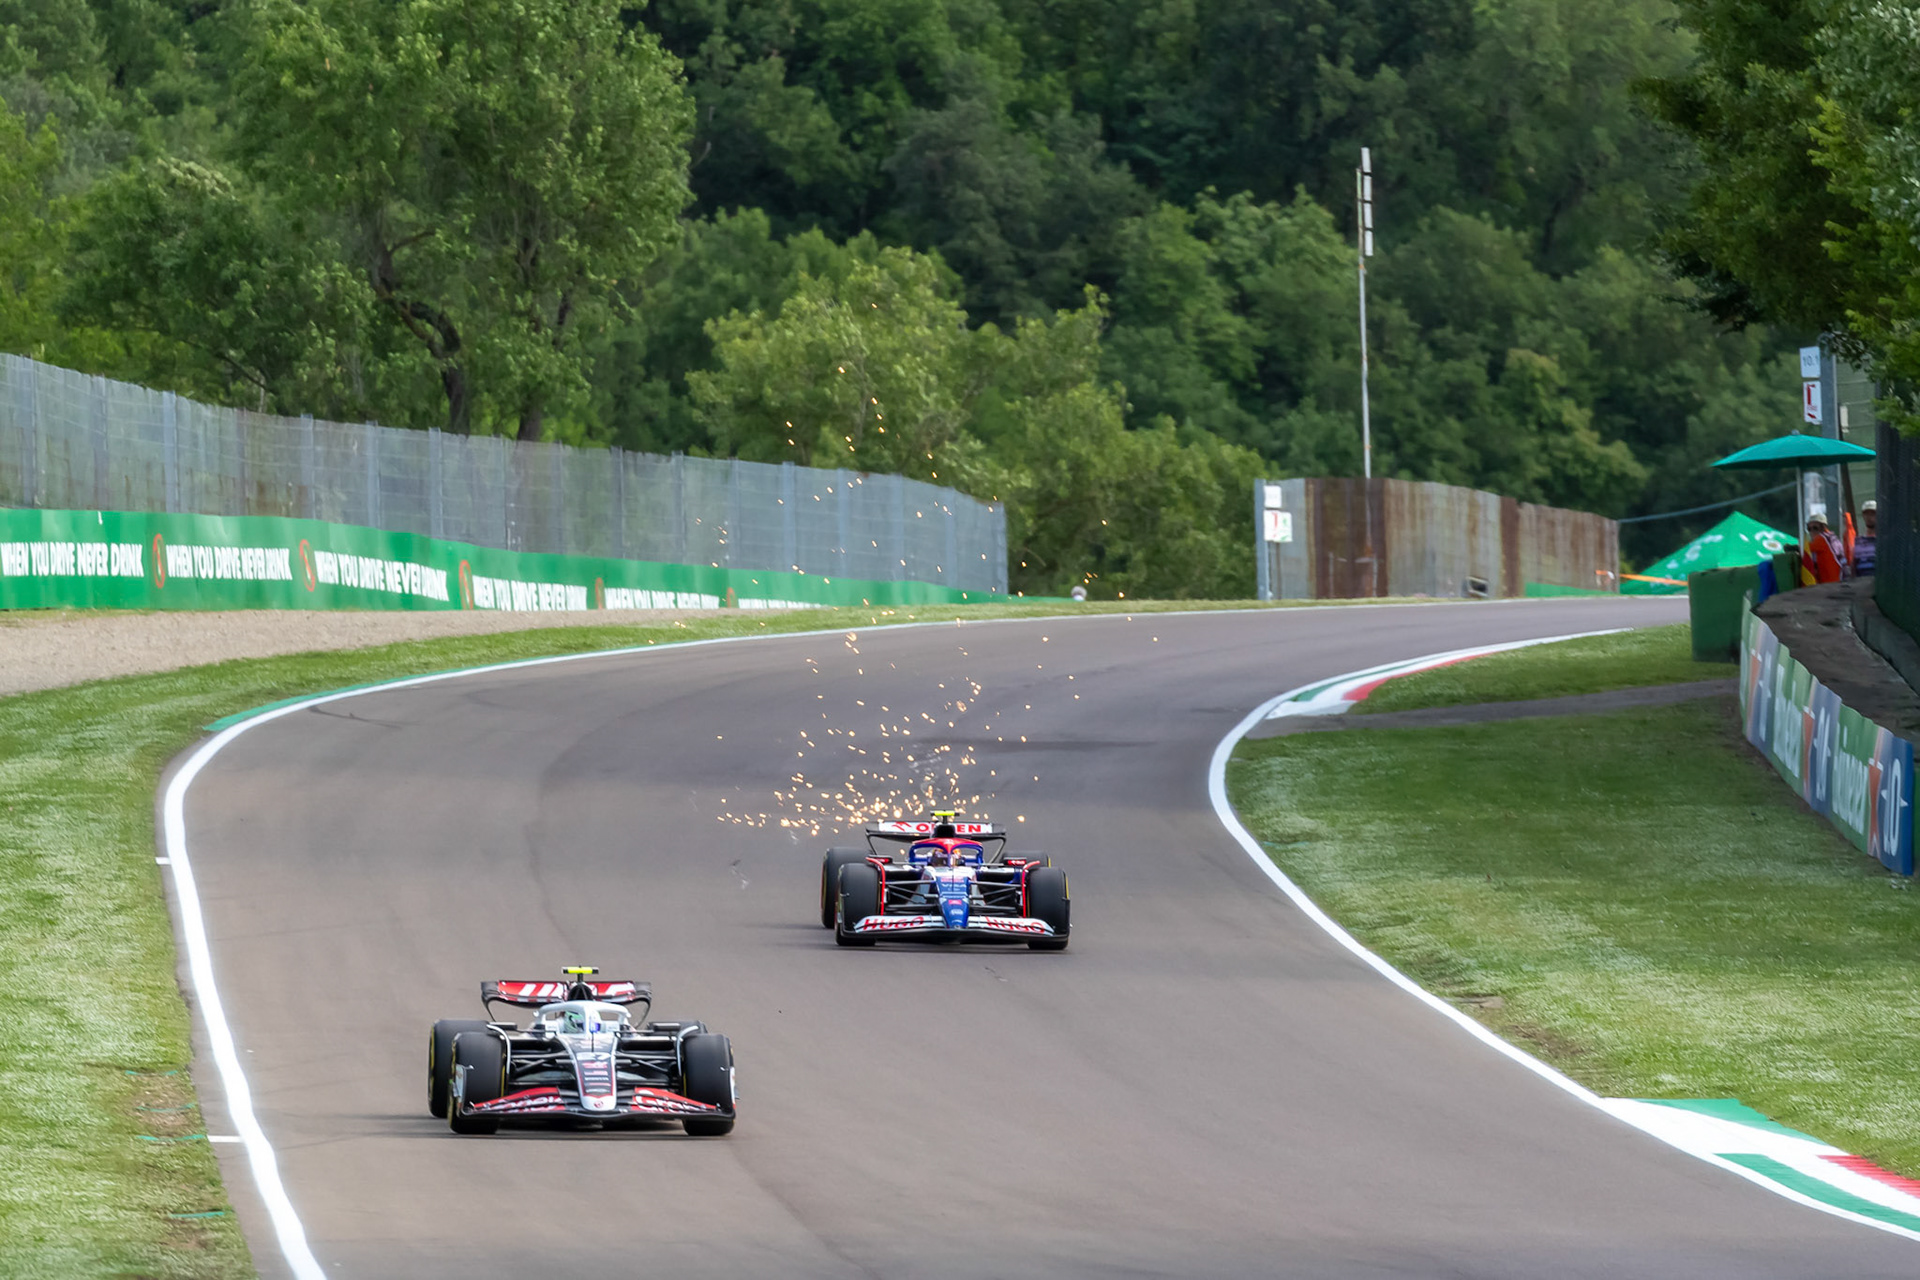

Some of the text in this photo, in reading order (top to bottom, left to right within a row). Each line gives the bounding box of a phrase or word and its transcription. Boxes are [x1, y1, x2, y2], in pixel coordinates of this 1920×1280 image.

[0, 541, 144, 577] WHEN YOU DRIVE NEVER DRINK
[166, 544, 193, 578] WHEN
[192, 545, 214, 579] YOU
[338, 553, 358, 588] YOU
[916, 823, 981, 833] OEN
[863, 915, 925, 931] HUGO
[985, 915, 1046, 934] HUGO
